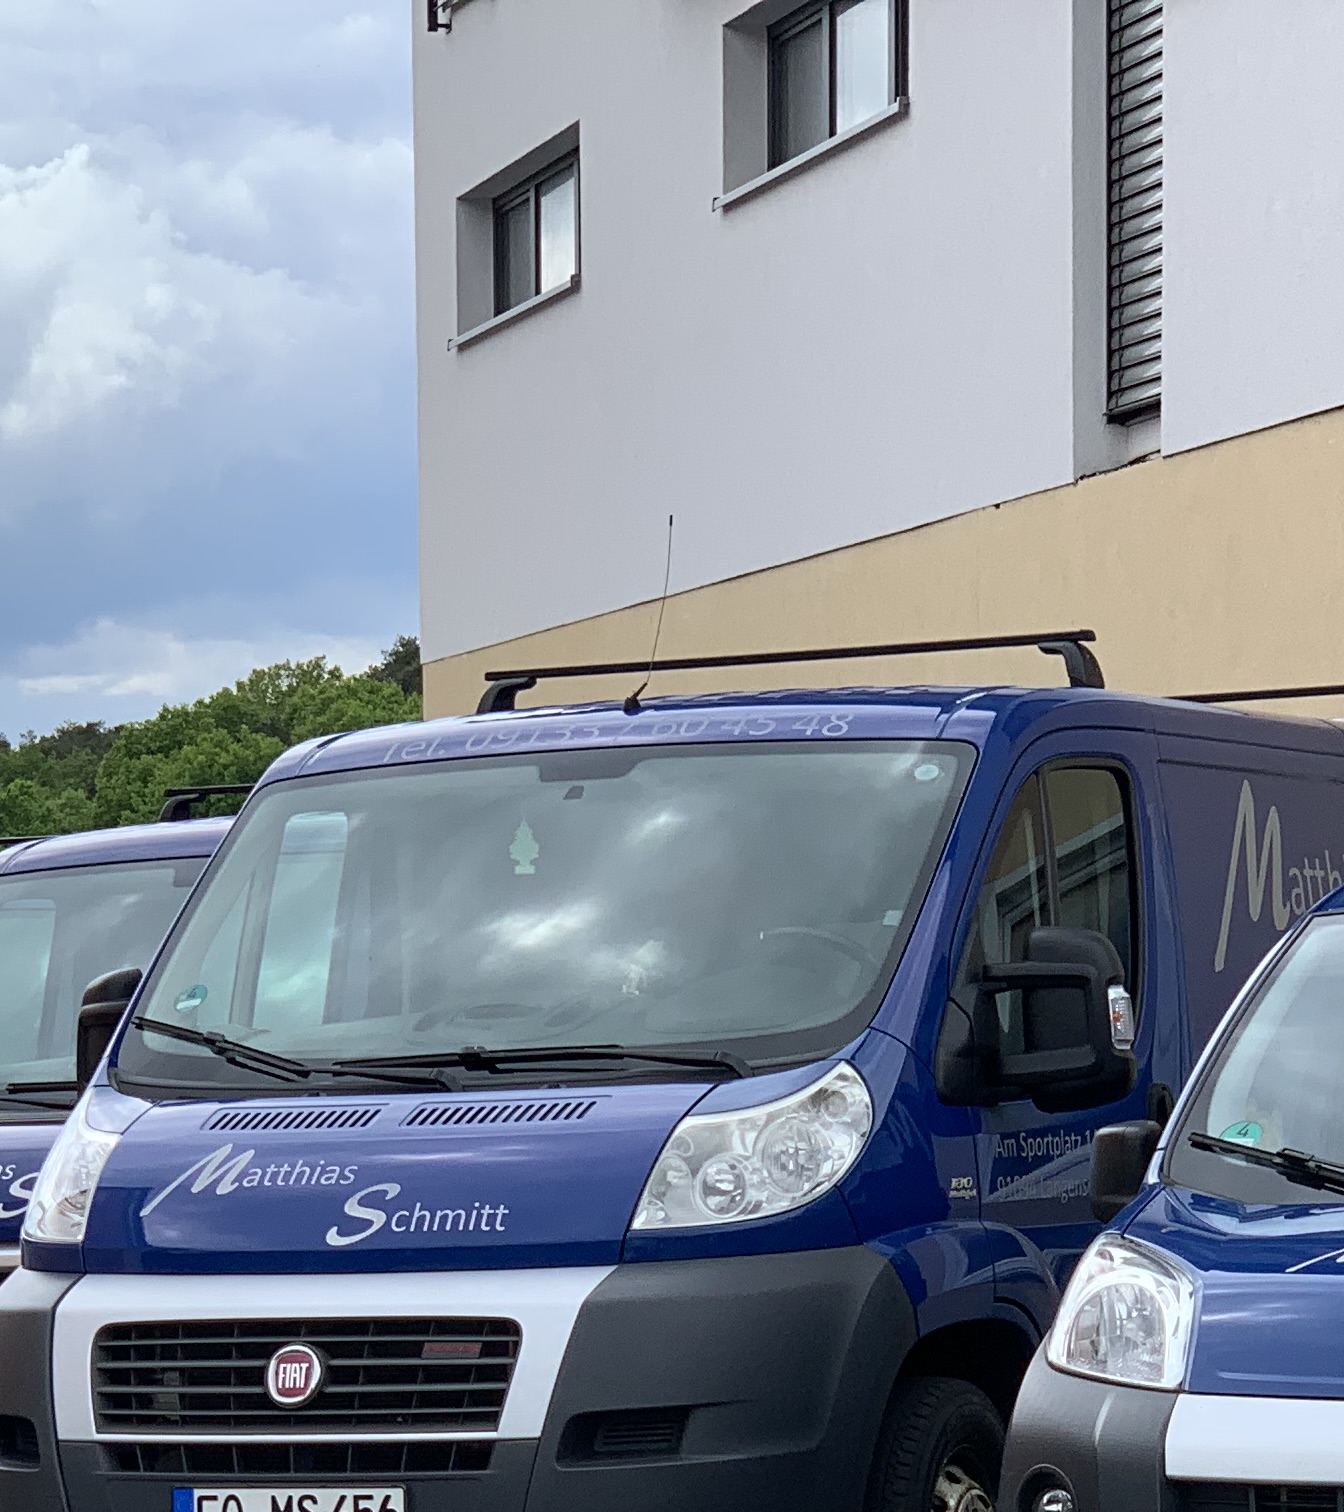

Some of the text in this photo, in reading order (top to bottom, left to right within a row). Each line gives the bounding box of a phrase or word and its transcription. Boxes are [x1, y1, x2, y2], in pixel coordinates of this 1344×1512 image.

[721, 716, 777, 736] 45
[792, 711, 854, 737] 48
[1236, 1121, 1252, 1137] 4
[995, 1133, 1018, 1158] Am
[1020, 1129, 1082, 1162] Sportplatz
[140, 1143, 358, 1216] Matthias
[326, 1182, 510, 1246] Schmitt
[278, 1362, 309, 1389] FIAT
